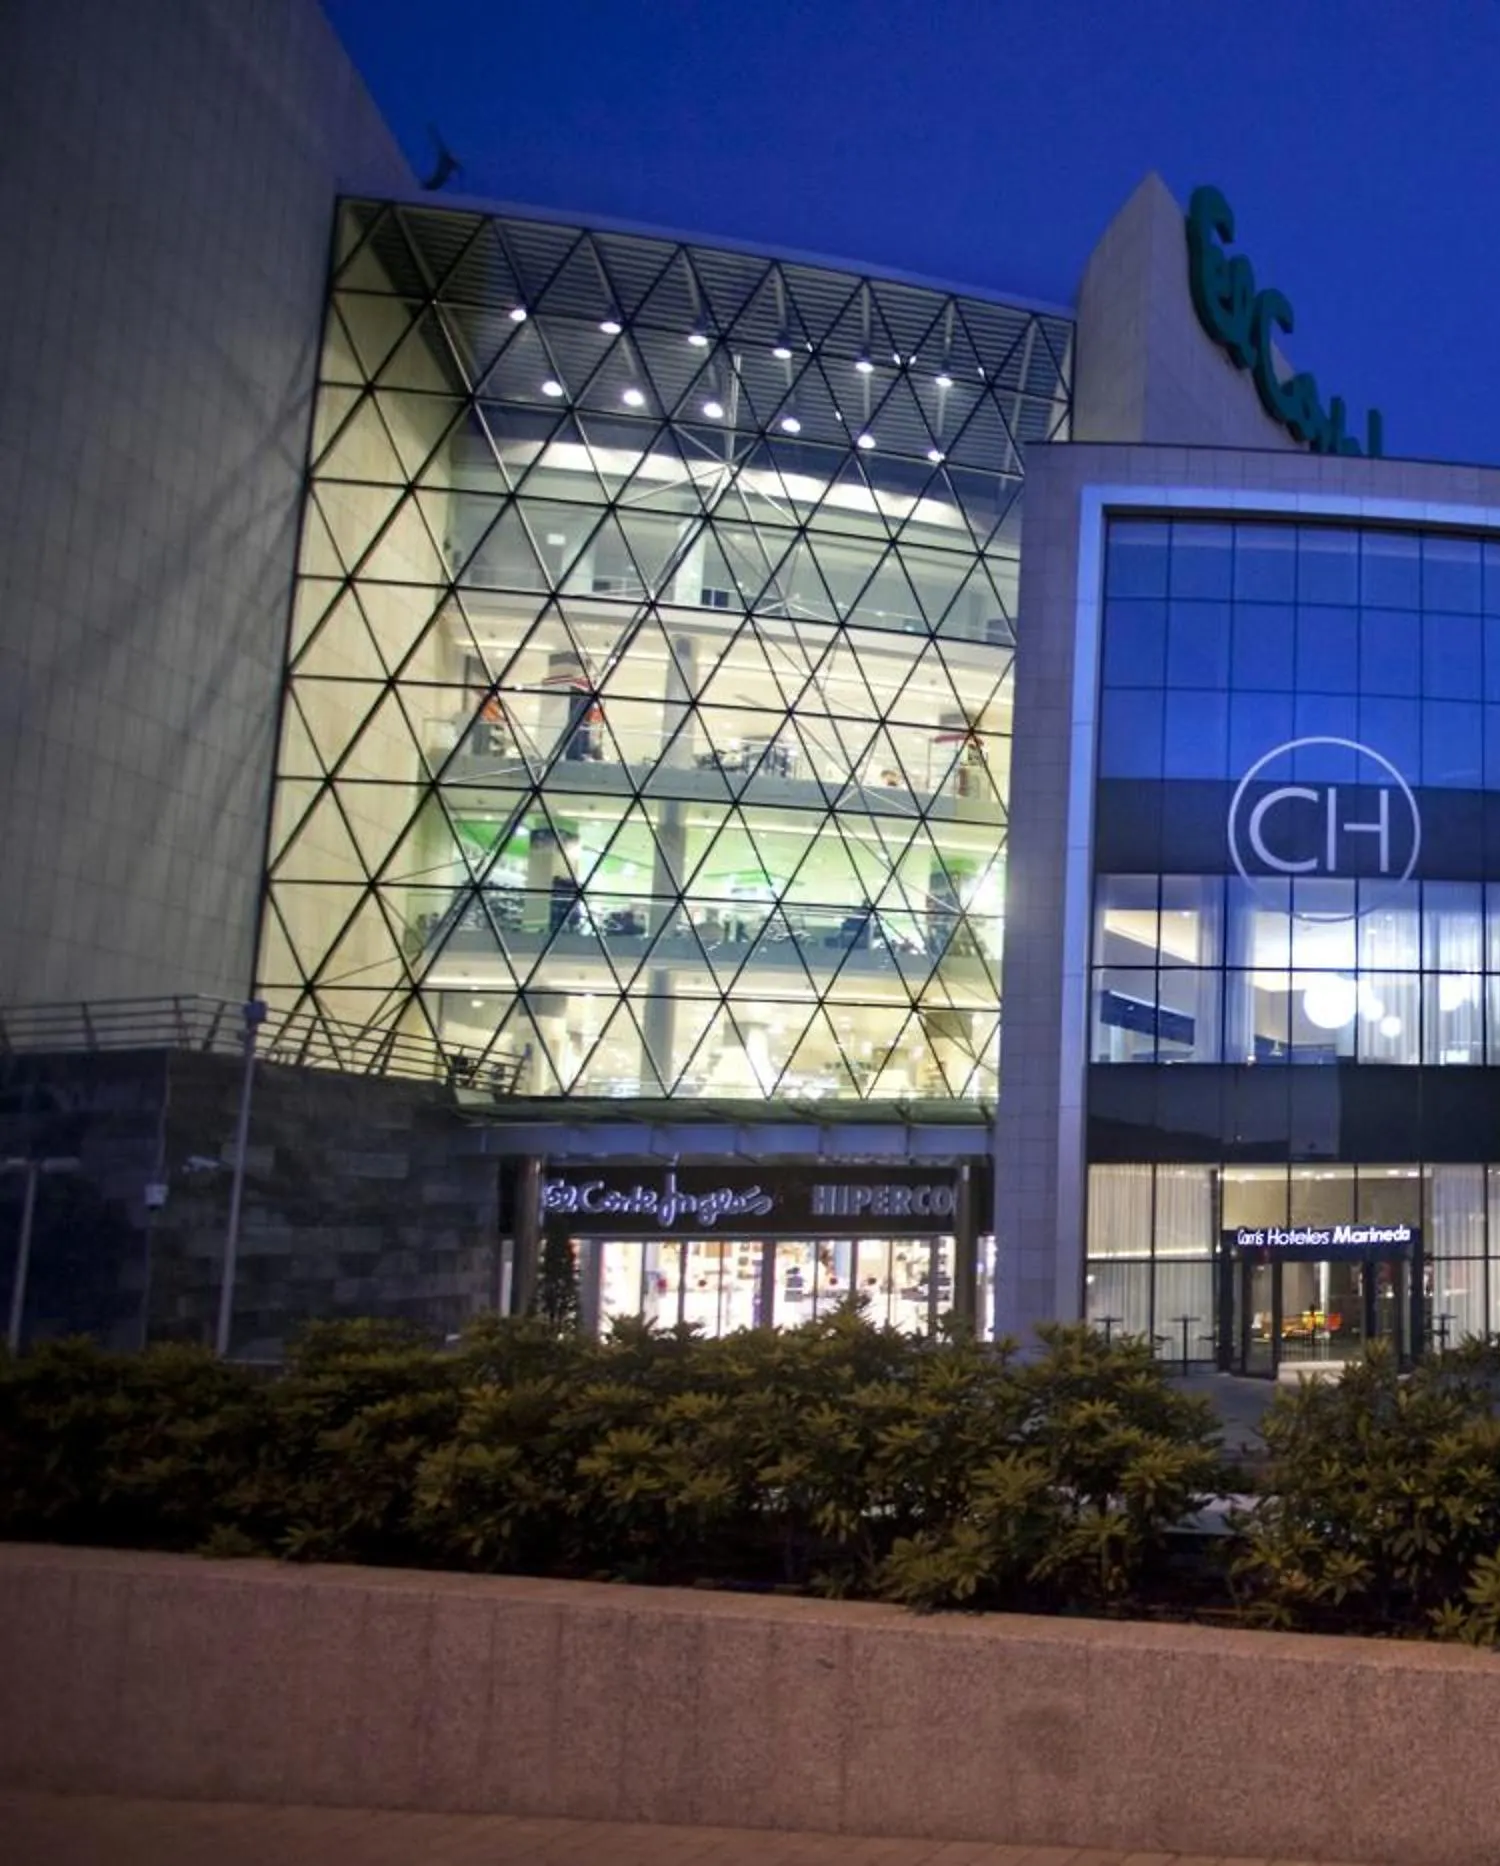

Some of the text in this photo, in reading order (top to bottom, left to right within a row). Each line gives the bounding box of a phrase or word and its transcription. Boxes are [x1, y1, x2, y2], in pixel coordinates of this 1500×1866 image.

[1250, 786, 1389, 873] CH
[812, 1184, 958, 1217] HIPERCO
[1267, 1227, 1330, 1246] Hoteles
[1332, 1224, 1411, 1245] Marineda
